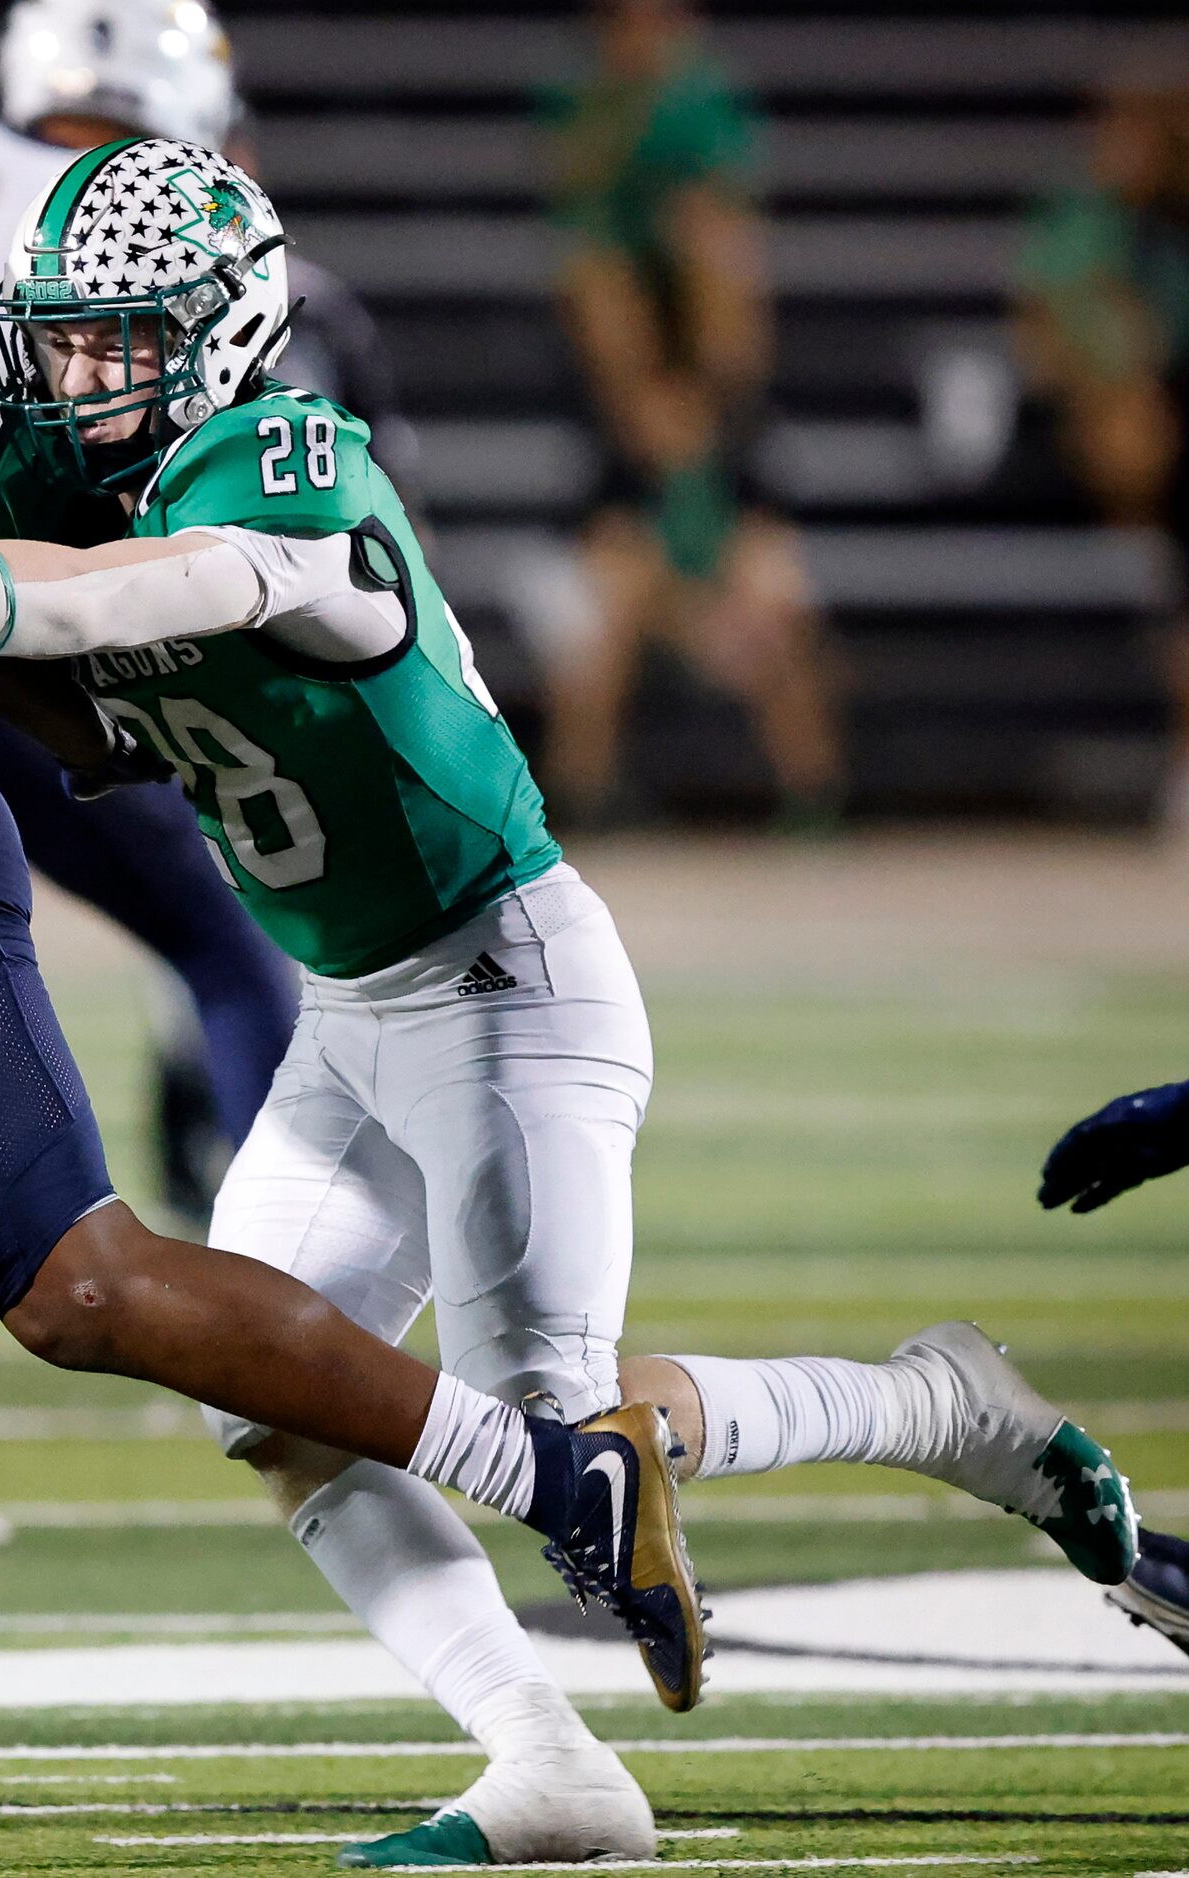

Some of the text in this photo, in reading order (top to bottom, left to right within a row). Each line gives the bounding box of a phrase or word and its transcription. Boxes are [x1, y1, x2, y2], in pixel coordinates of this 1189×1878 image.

[16, 280, 73, 300] 76092
[257, 415, 337, 497] 28
[72, 639, 204, 688] AGONS
[458, 975, 518, 997] adidas
